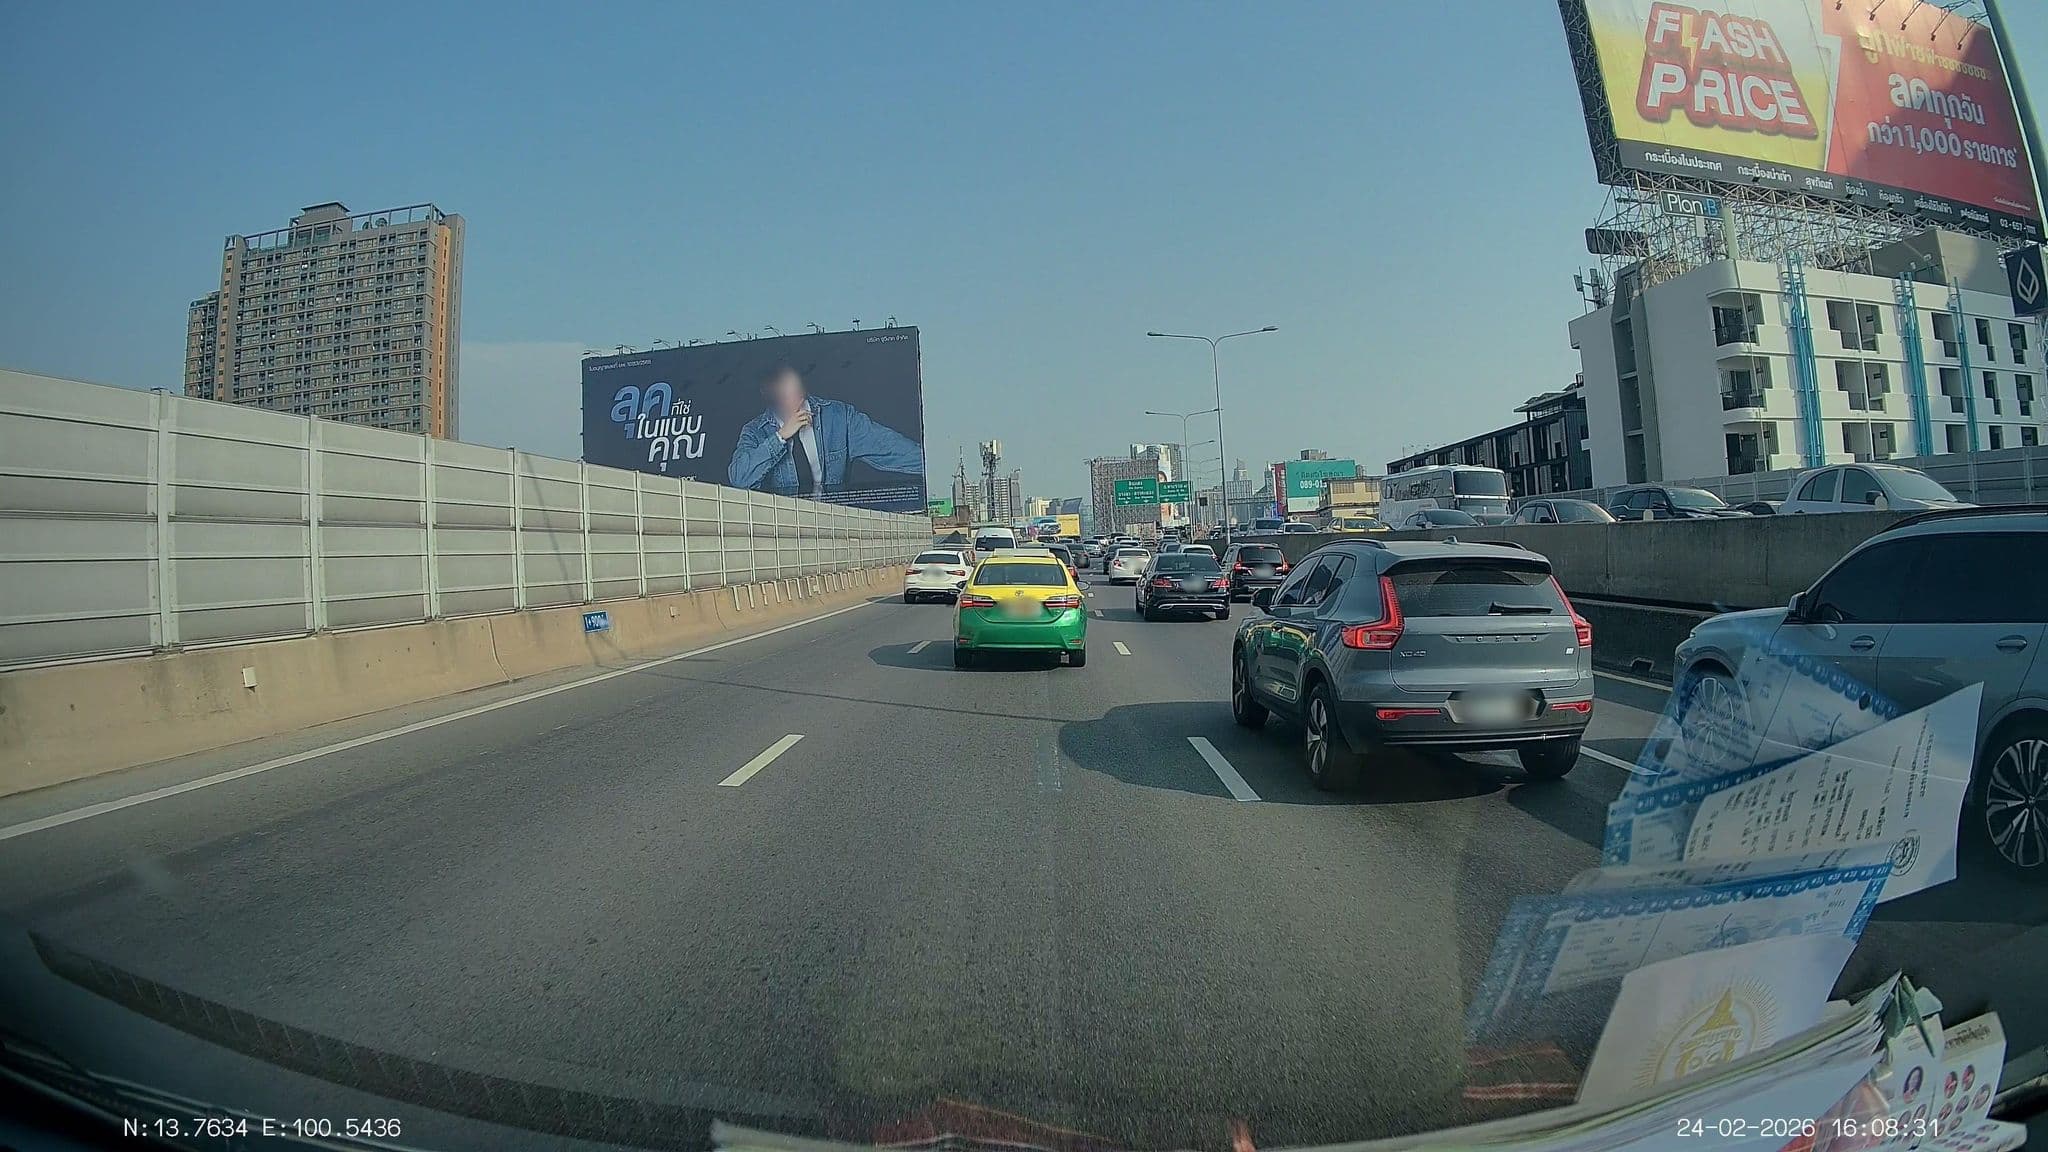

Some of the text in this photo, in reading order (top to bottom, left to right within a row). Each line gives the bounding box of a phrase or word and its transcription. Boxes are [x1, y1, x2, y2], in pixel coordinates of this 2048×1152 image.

[1653, 9, 1784, 68] FLASH
[1647, 62, 1809, 126] PRICE
[1888, 73, 1986, 129] ลดทุกวัน
[1867, 116, 1904, 147] กว่า
[1905, 124, 1962, 155] 1,000
[1645, 148, 1723, 172] กระเบื้องในประเทศ
[1667, 193, 1703, 214] Plan
[611, 382, 672, 439] ลุค
[637, 413, 702, 439] ในแบบ
[671, 398, 692, 415] ที่ใช่
[648, 433, 706, 472] คุณ
